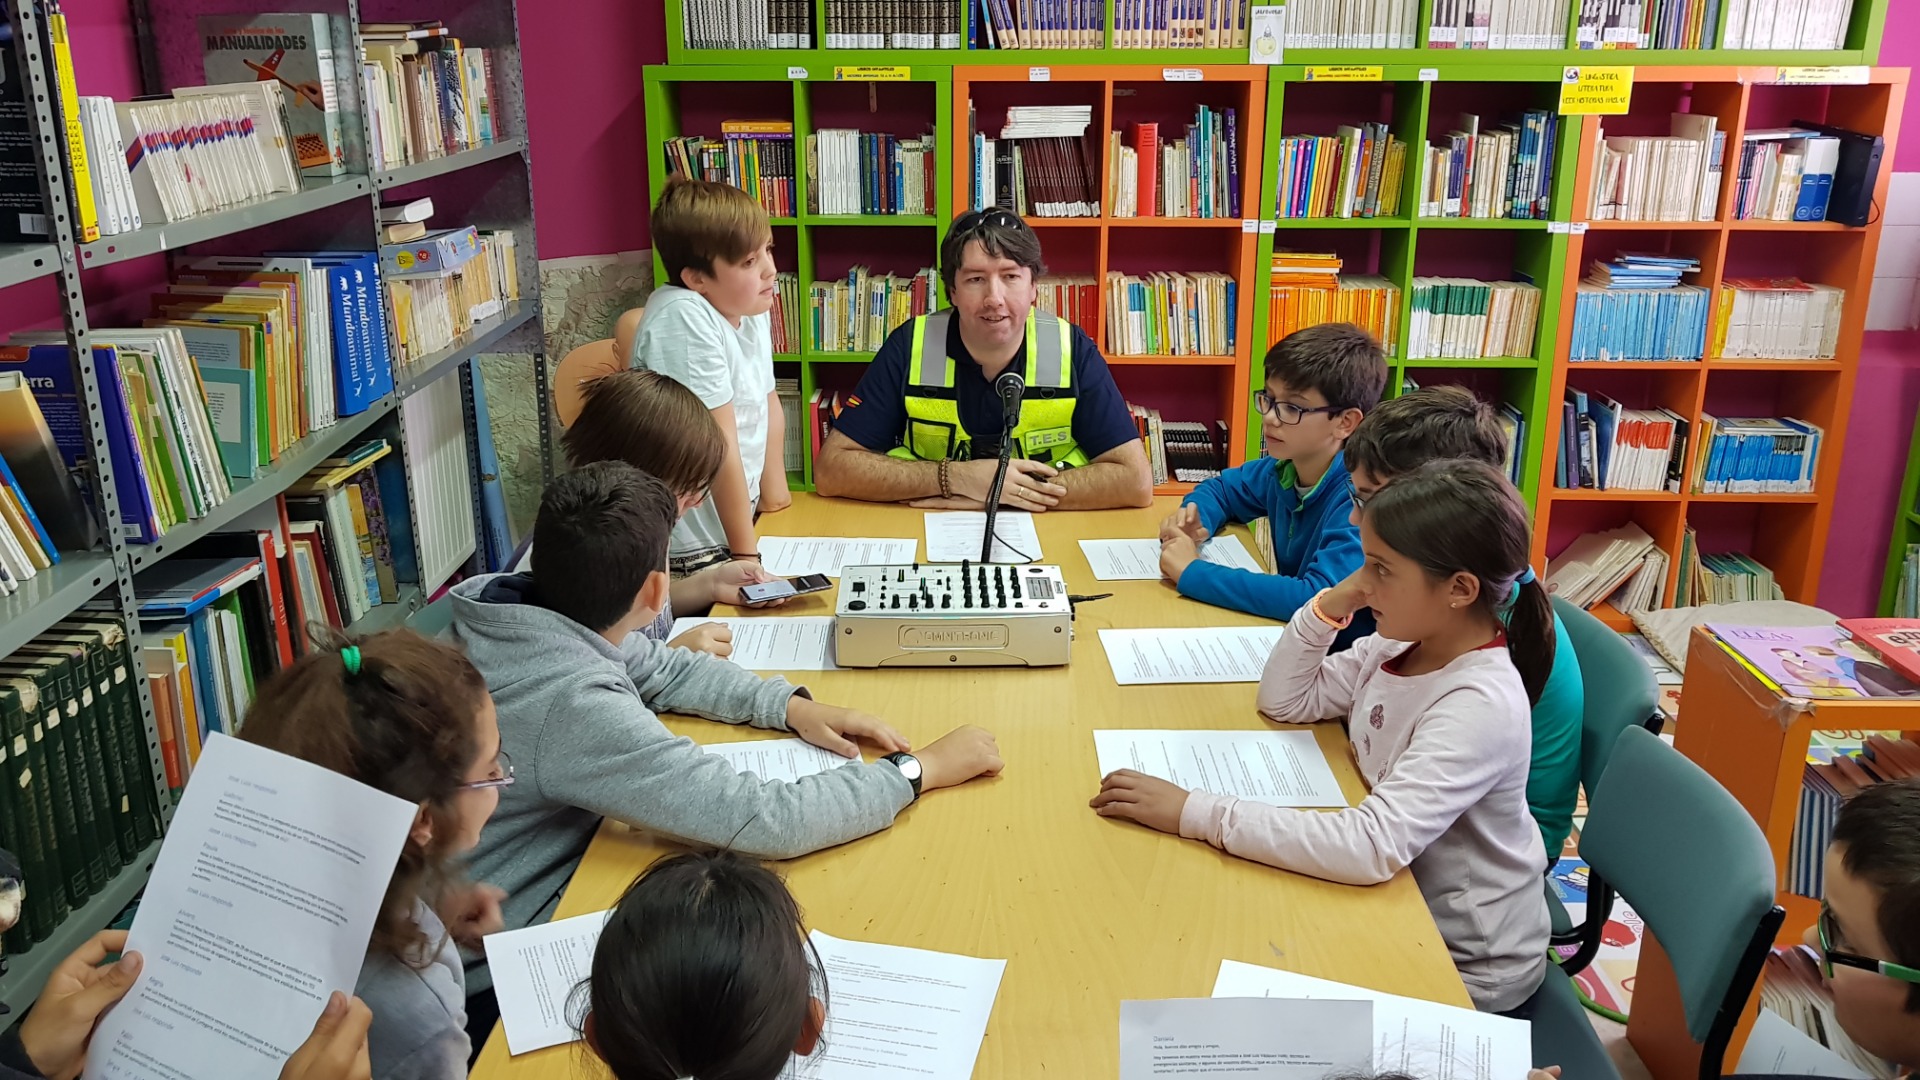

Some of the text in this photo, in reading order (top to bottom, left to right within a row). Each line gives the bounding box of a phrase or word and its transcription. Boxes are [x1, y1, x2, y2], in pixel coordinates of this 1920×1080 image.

[206, 36, 307, 50] MANUALIDADES
[341, 293, 361, 382] Mundoanimal
[356, 286, 375, 372] Mundoanimal
[374, 278, 390, 362] Mundoanimal
[1731, 629, 1794, 641] ELLAS
